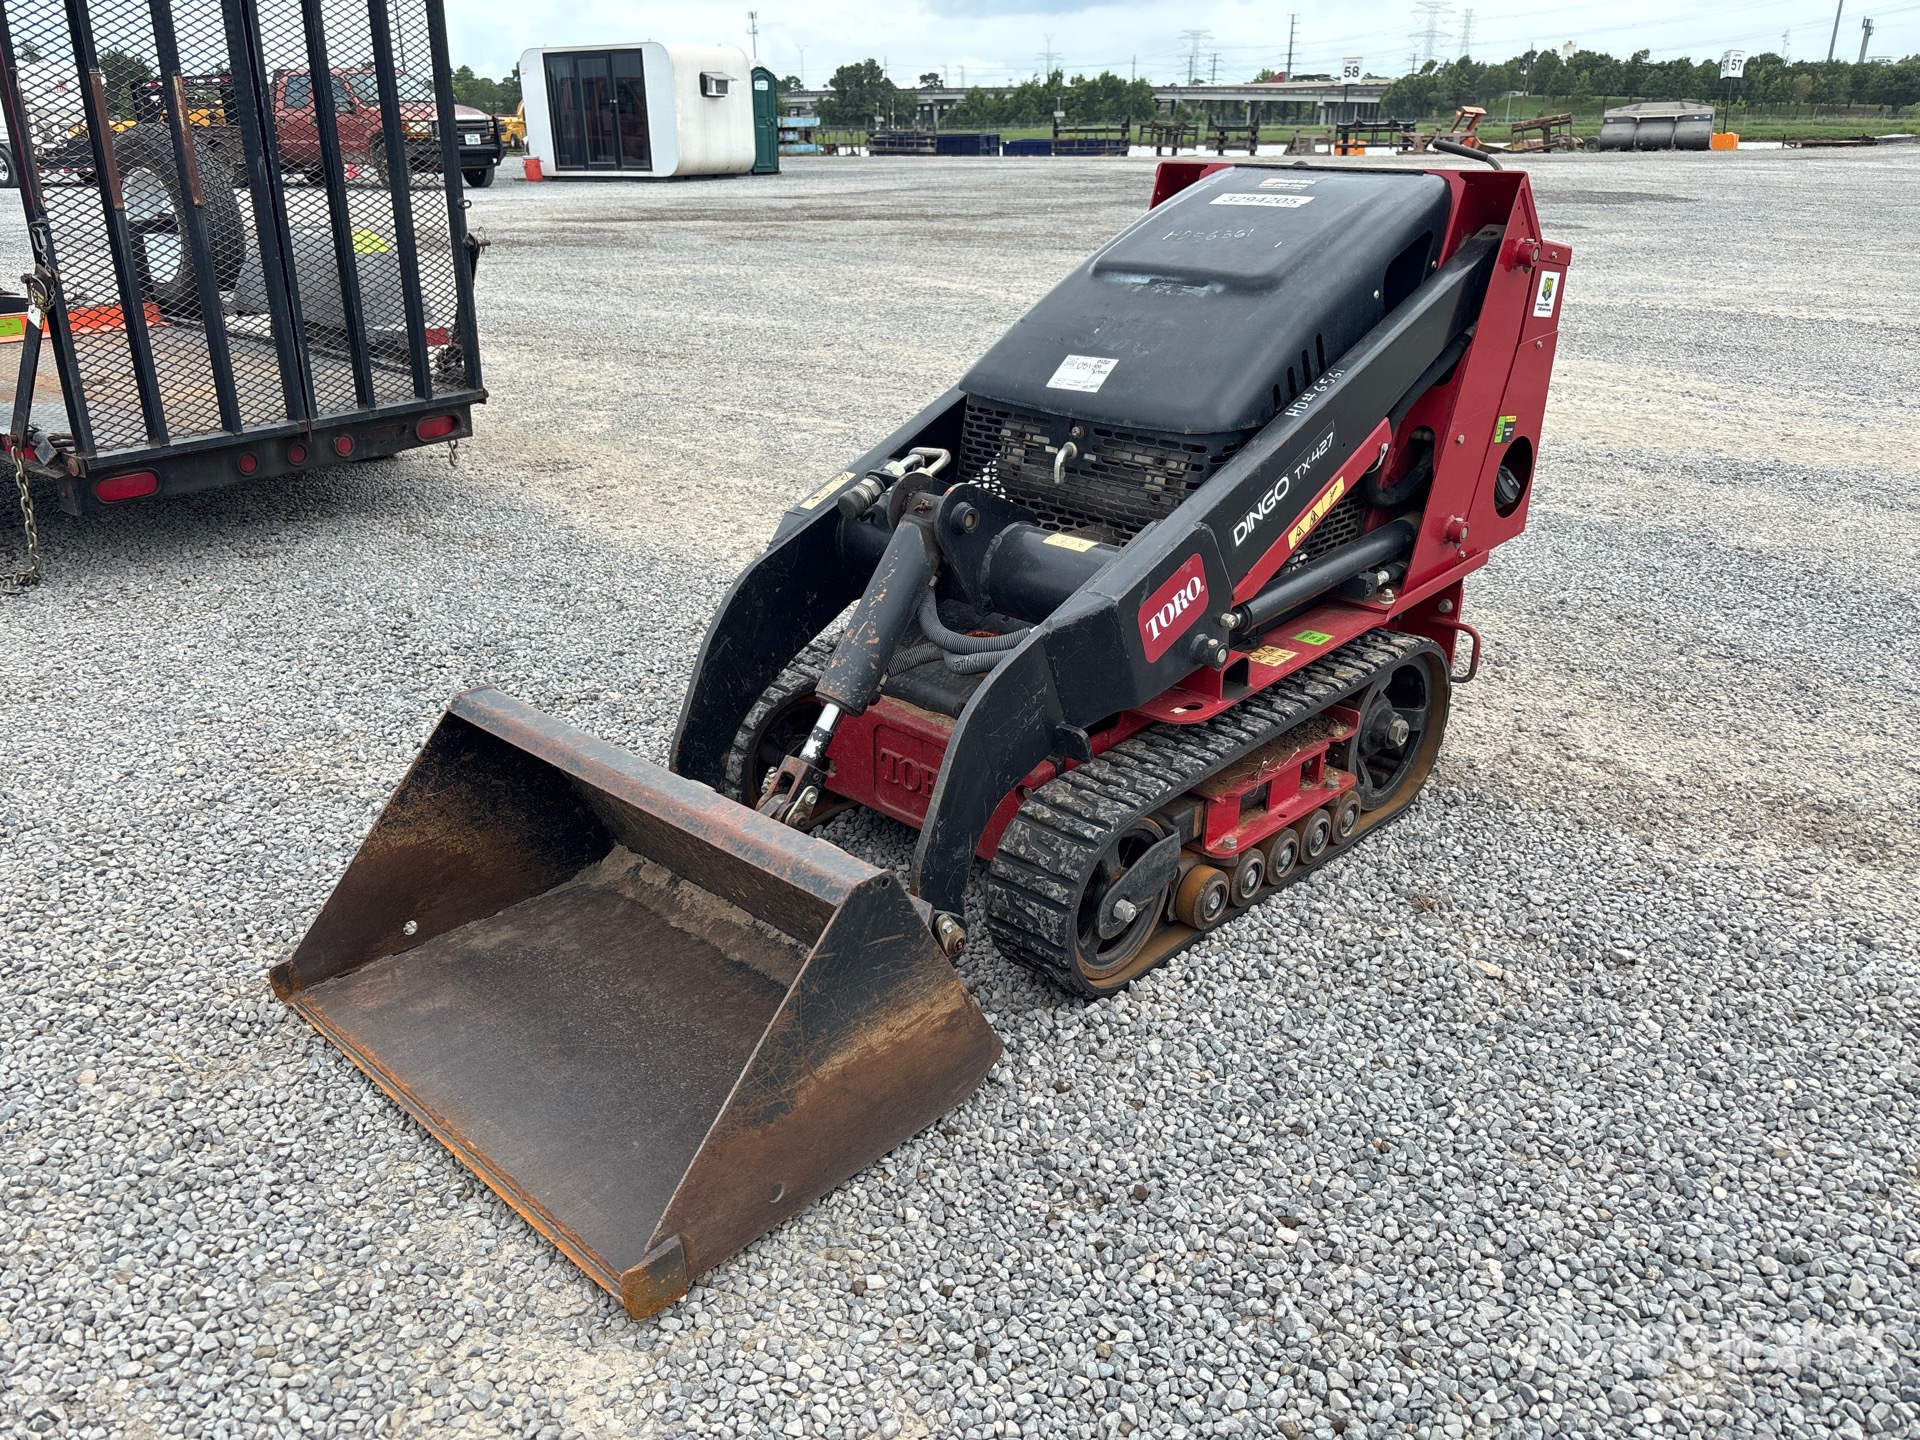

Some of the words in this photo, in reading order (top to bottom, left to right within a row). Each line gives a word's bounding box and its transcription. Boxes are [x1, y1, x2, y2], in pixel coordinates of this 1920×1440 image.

[1731, 59, 1743, 71] 57
[1343, 66, 1360, 78] 58
[1222, 195, 1298, 206] 3294205
[1233, 476, 1290, 547] DINGO
[1145, 576, 1203, 642] TORO
